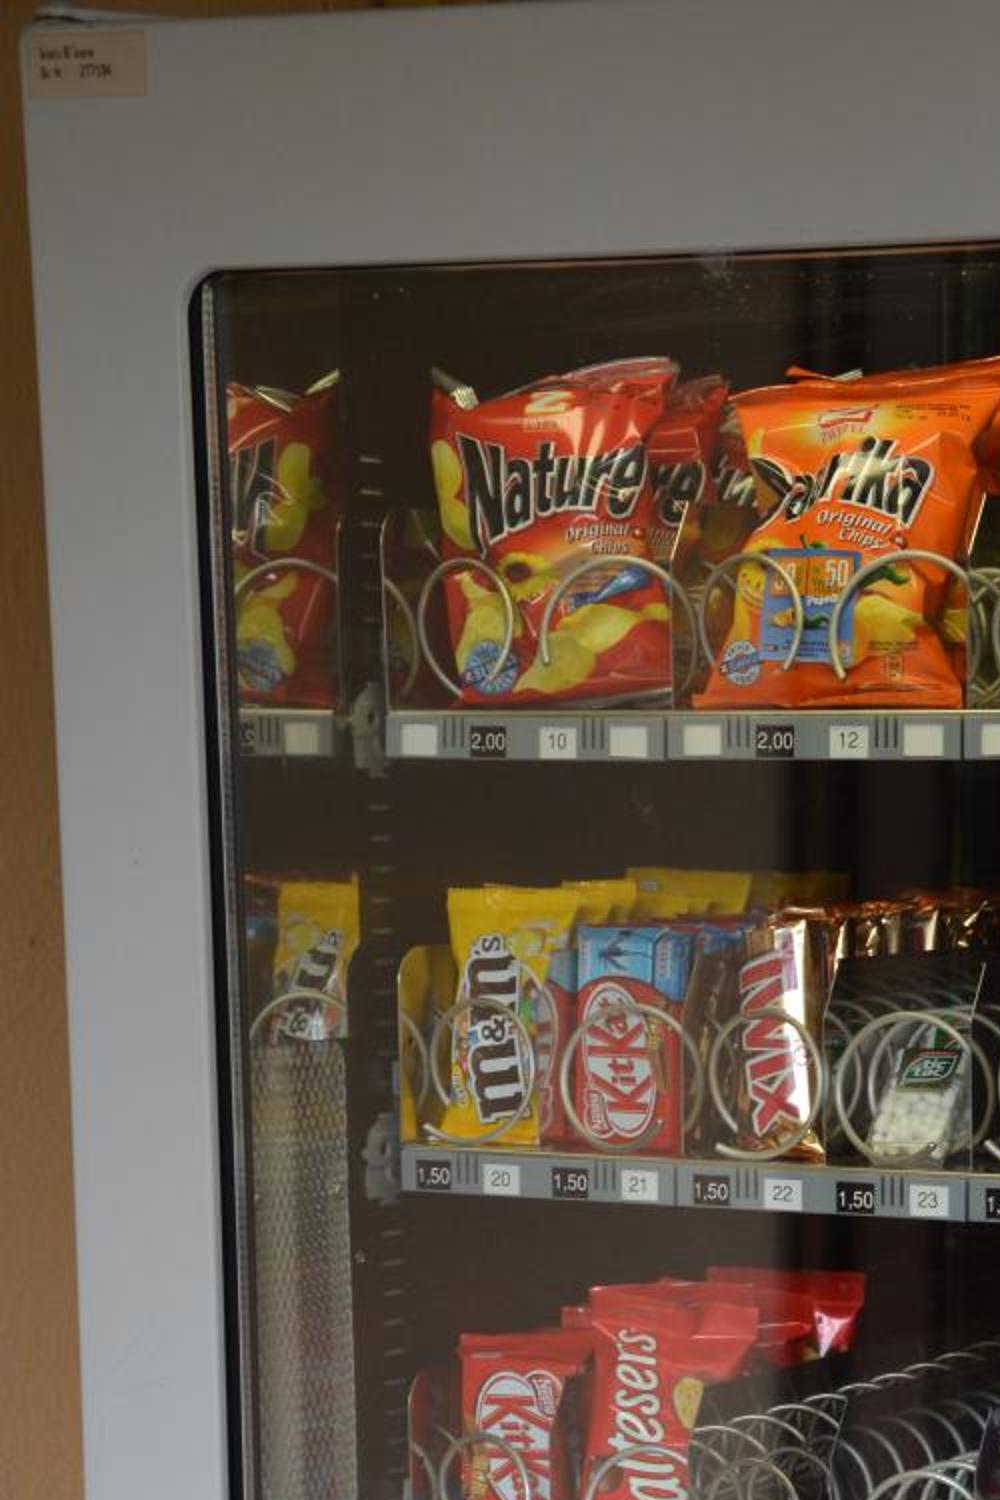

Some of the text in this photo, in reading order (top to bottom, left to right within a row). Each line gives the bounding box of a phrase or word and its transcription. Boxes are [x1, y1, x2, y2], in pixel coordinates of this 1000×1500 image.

[456, 432, 648, 559] Nature
[816, 508, 891, 535] Original
[838, 527, 888, 549] Chips
[471, 732, 506, 752] 2,00
[547, 733, 568, 751] 10
[757, 732, 793, 752] 2,00
[838, 731, 860, 750] 12
[491, 1172, 511, 1187] 20
[553, 1173, 587, 1193] 1,50
[629, 1174, 647, 1192] 21
[773, 1185, 793, 1202] 22
[839, 1190, 874, 1209] 1,50
[918, 1191, 939, 1209] 23
